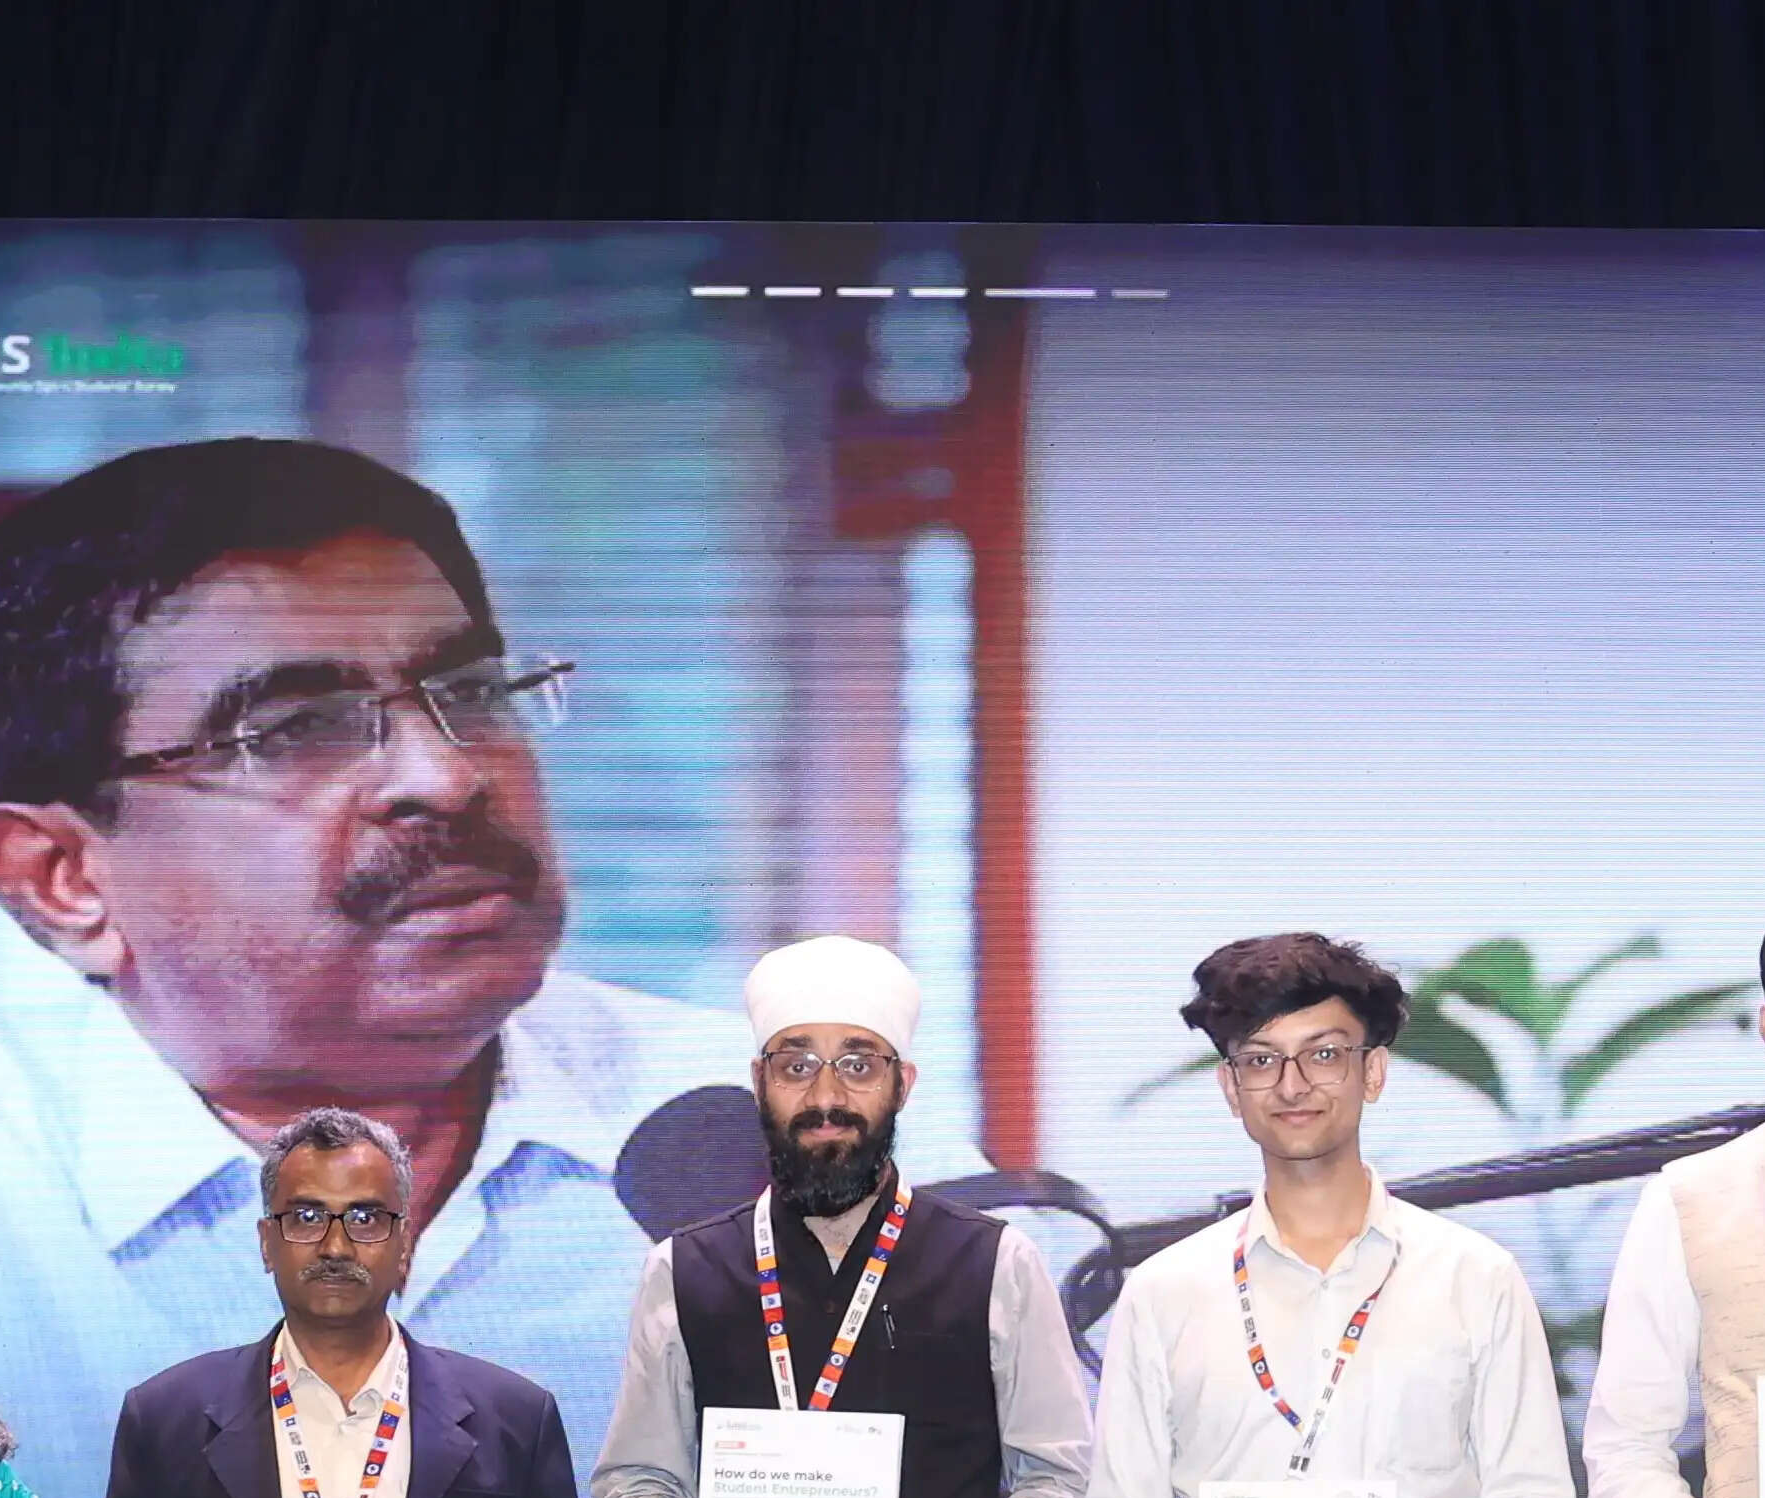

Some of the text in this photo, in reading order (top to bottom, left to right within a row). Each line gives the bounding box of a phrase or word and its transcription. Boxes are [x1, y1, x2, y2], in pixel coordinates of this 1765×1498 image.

[714, 1468, 833, 1482] How do we make
[714, 1482, 767, 1495] Student
